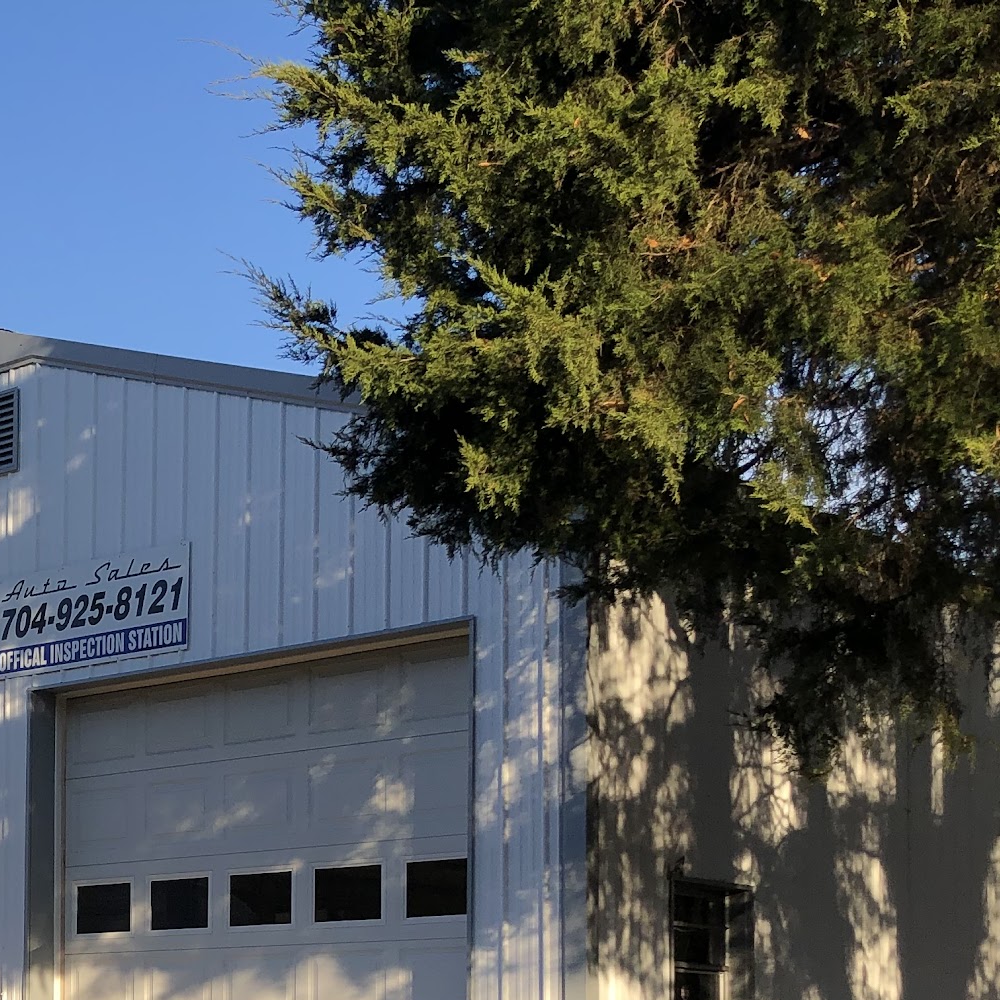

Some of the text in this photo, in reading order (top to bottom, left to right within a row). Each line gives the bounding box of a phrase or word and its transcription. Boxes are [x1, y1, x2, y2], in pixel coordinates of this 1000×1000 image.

[1, 557, 182, 603] Auto Sales
[1, 576, 184, 641] 704-925-8121
[49, 632, 126, 665] INSPECTION
[127, 621, 183, 652] STATION
